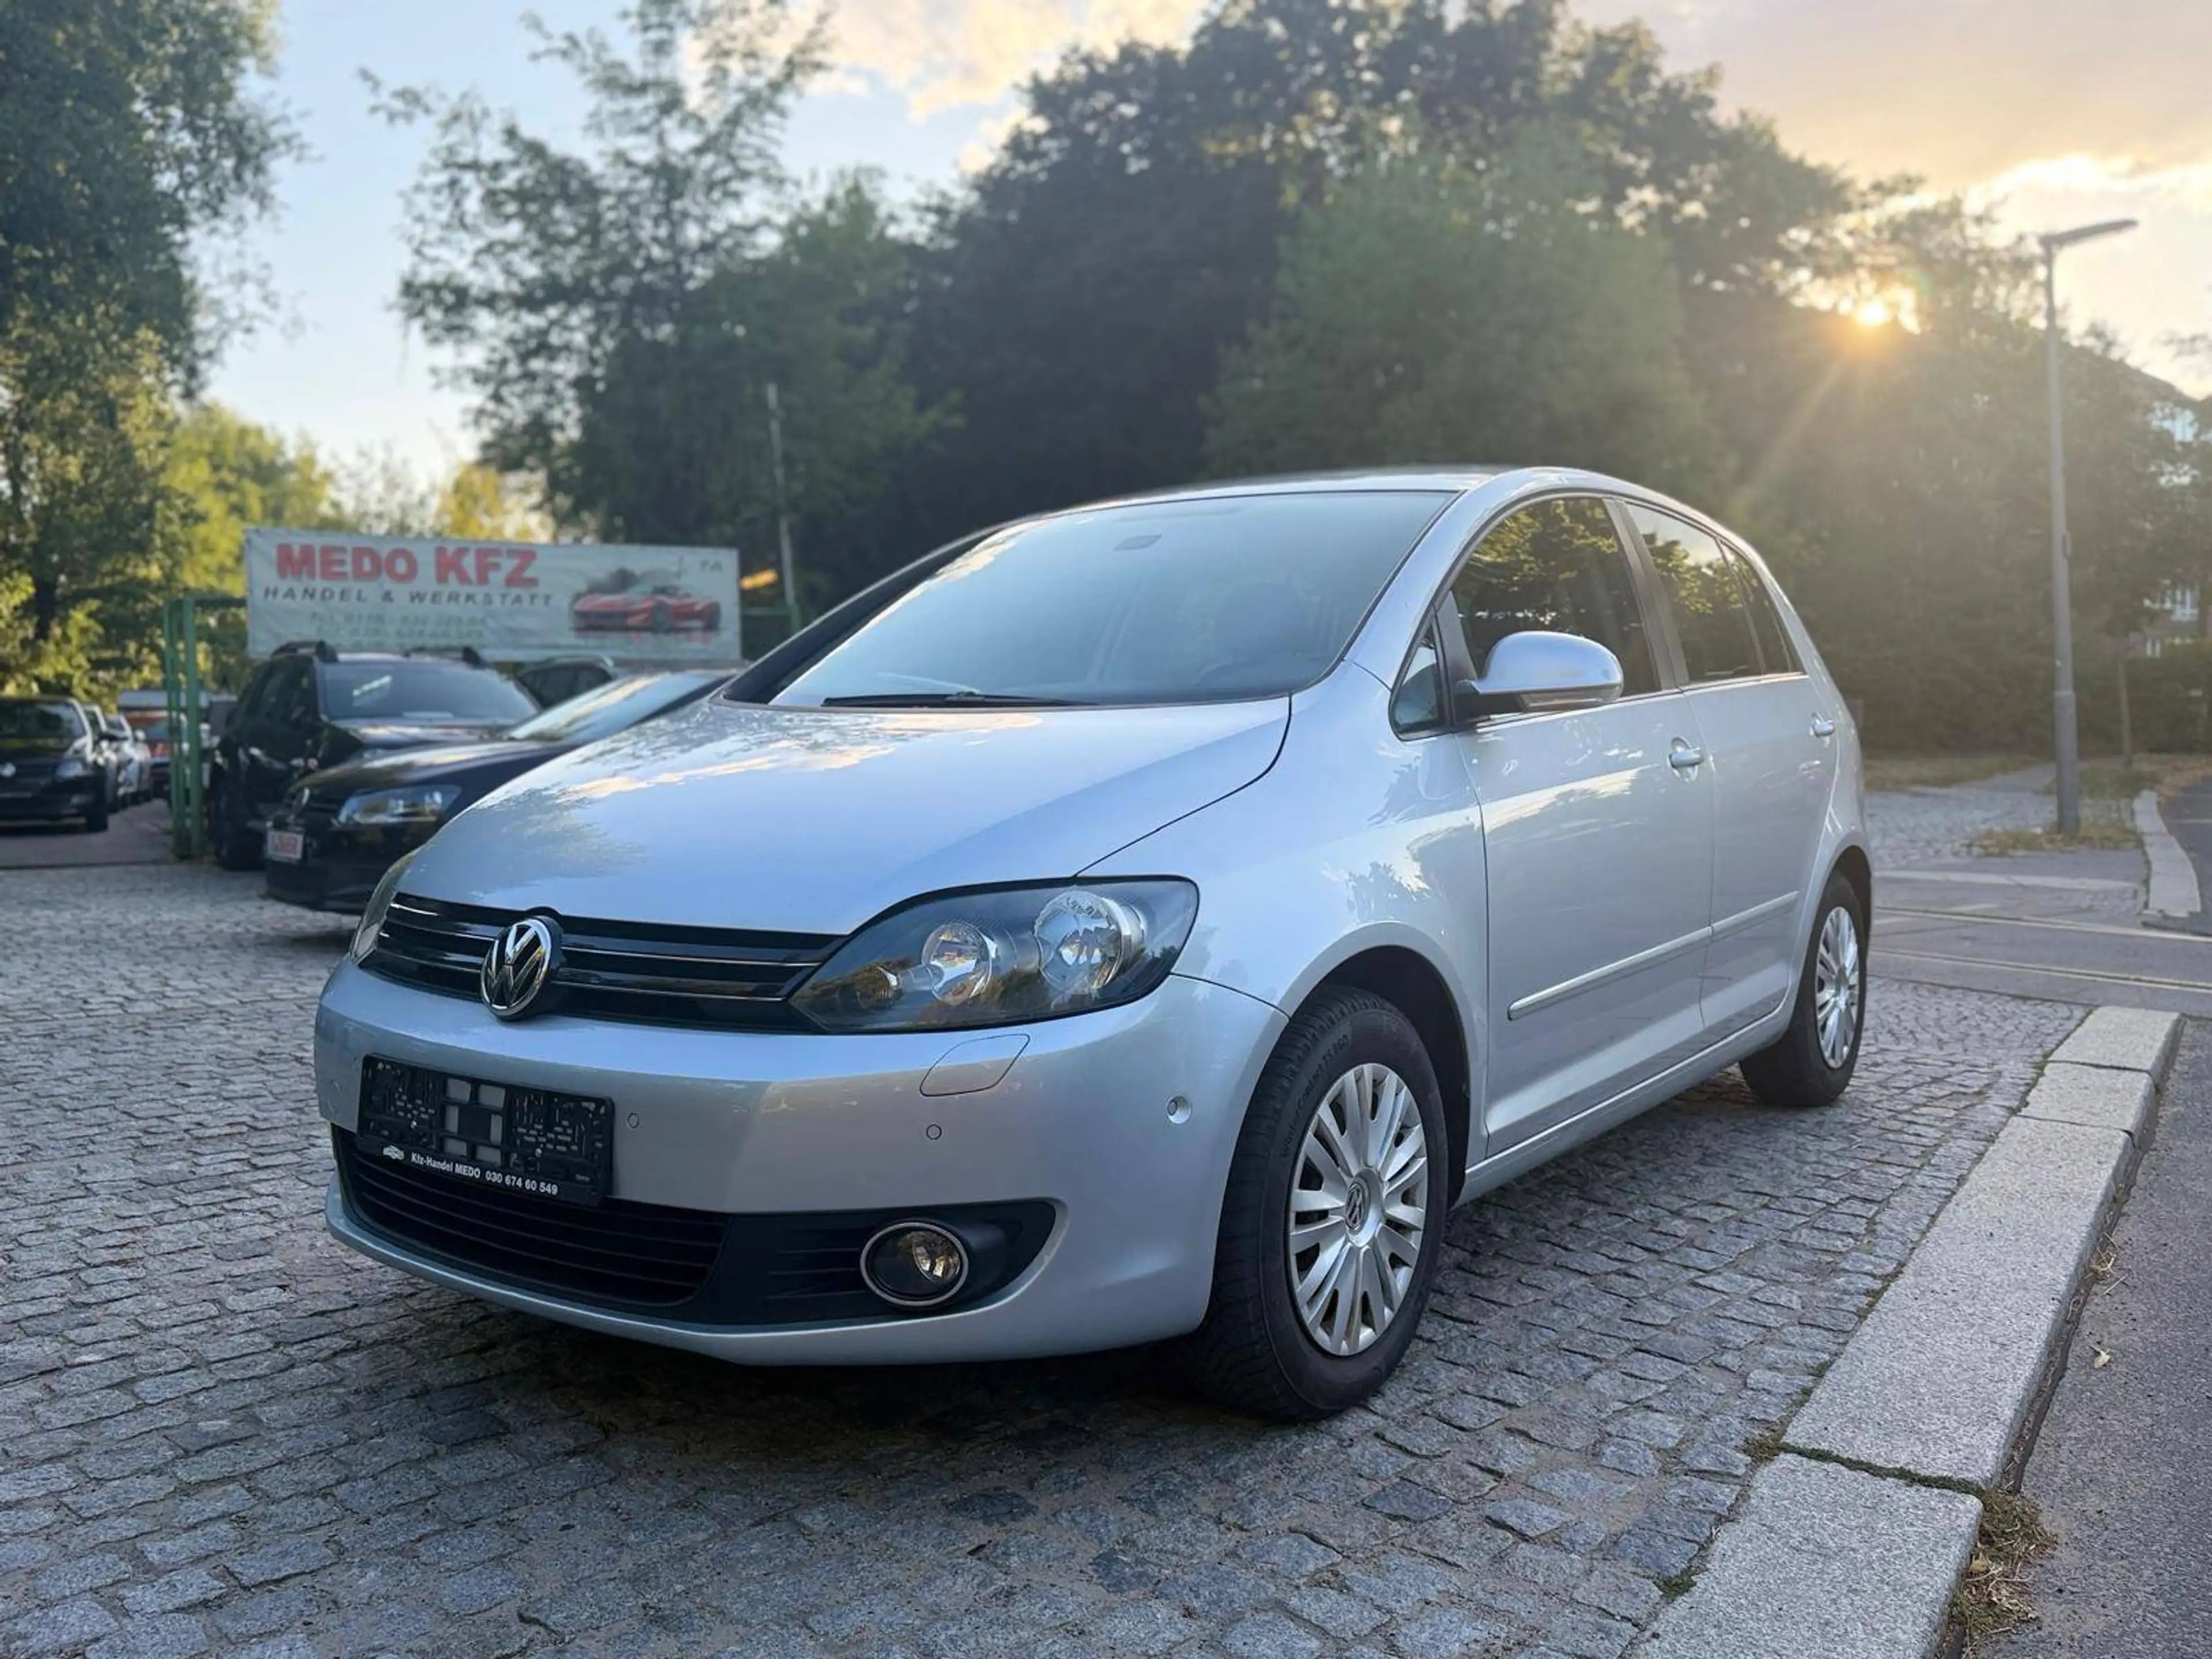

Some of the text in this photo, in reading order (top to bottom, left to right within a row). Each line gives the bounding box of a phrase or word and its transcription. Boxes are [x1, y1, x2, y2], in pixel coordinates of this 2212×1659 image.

[276, 544, 539, 588] MEDO KFZ
[263, 585, 554, 607] HANDEL & WERKSTATT
[411, 1152, 558, 1196] Kfz-Handel MEDO 030 674 60 549
